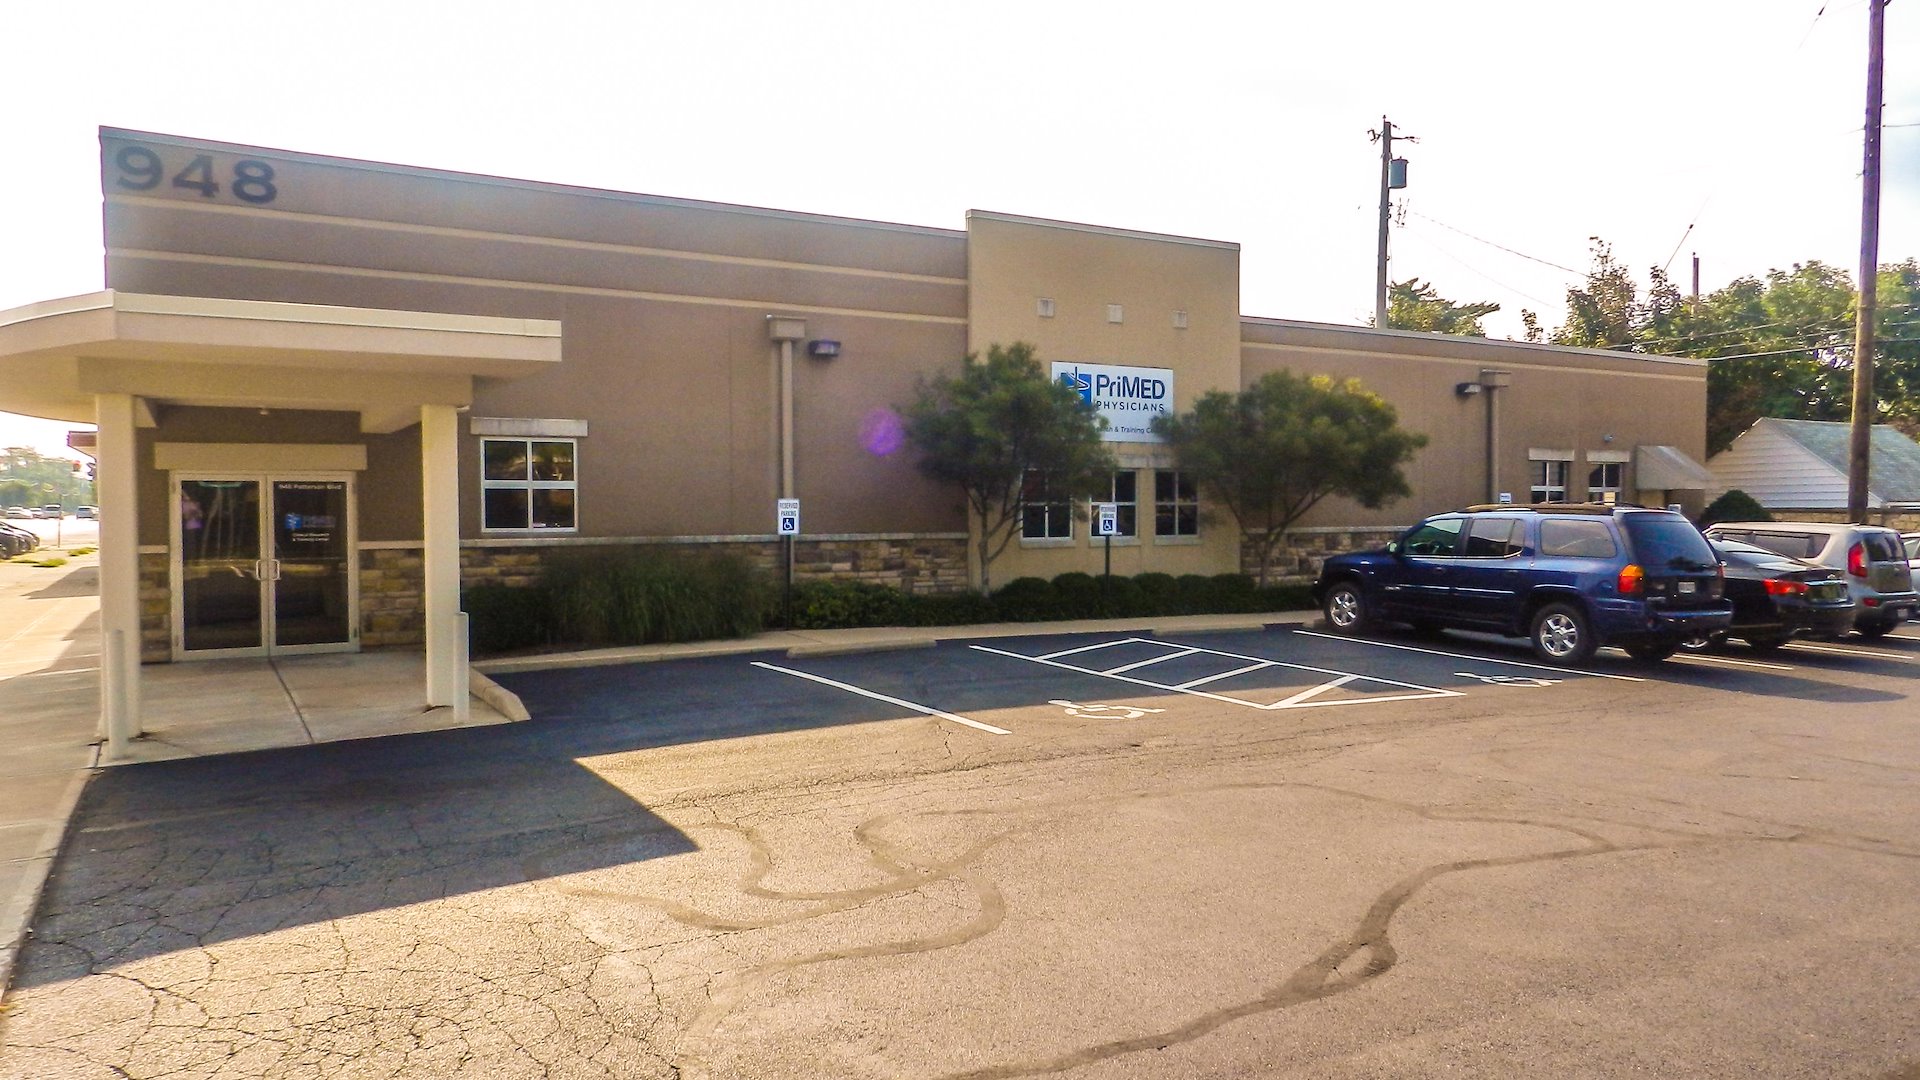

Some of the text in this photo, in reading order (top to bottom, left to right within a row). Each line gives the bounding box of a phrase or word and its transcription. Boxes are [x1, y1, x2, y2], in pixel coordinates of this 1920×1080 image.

[116, 146, 277, 204] 948
[1096, 374, 1165, 399] PriMED
[1096, 401, 1165, 411] PHYSICIANS
[1121, 426, 1145, 434] Training
